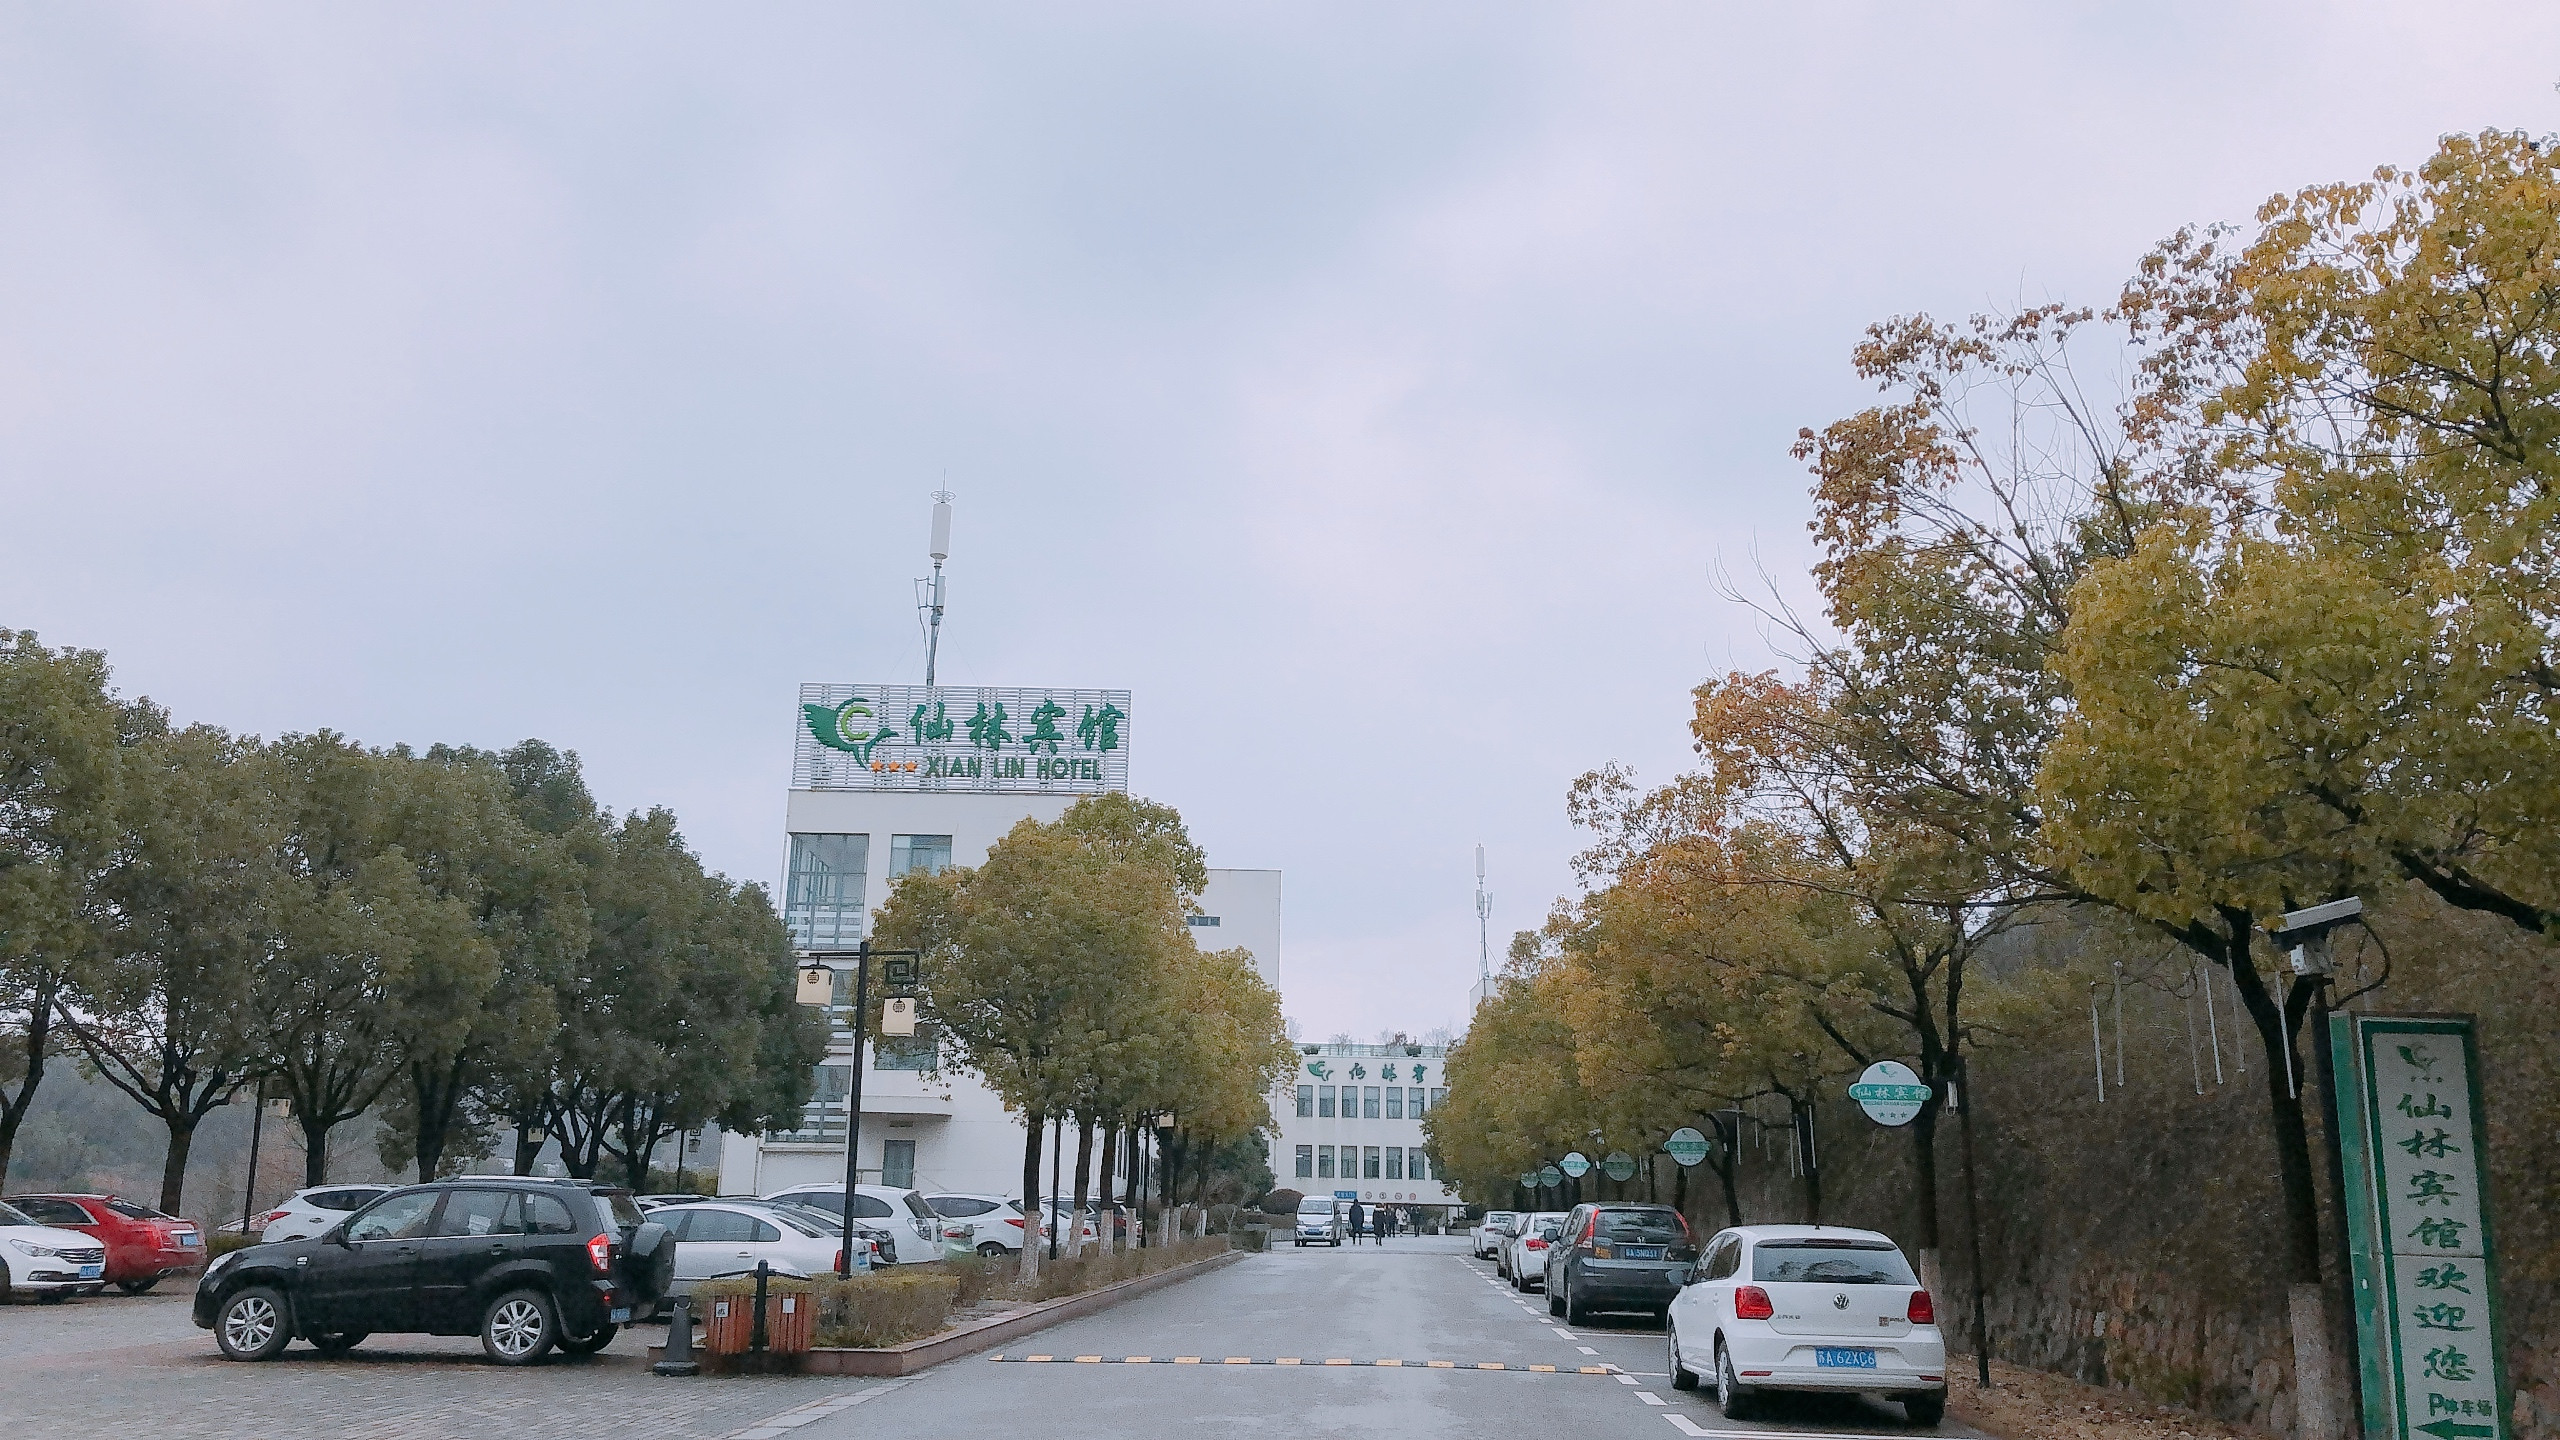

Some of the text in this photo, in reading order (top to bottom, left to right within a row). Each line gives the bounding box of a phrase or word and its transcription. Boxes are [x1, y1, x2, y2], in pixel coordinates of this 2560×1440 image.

[909, 698, 1125, 754] 仙林宾馆
[925, 756, 1101, 780] XIAN LIN HOTEL
[1348, 1062, 1448, 1084] 仙林宾
[1855, 1085, 1928, 1100] 仙林宾馆
